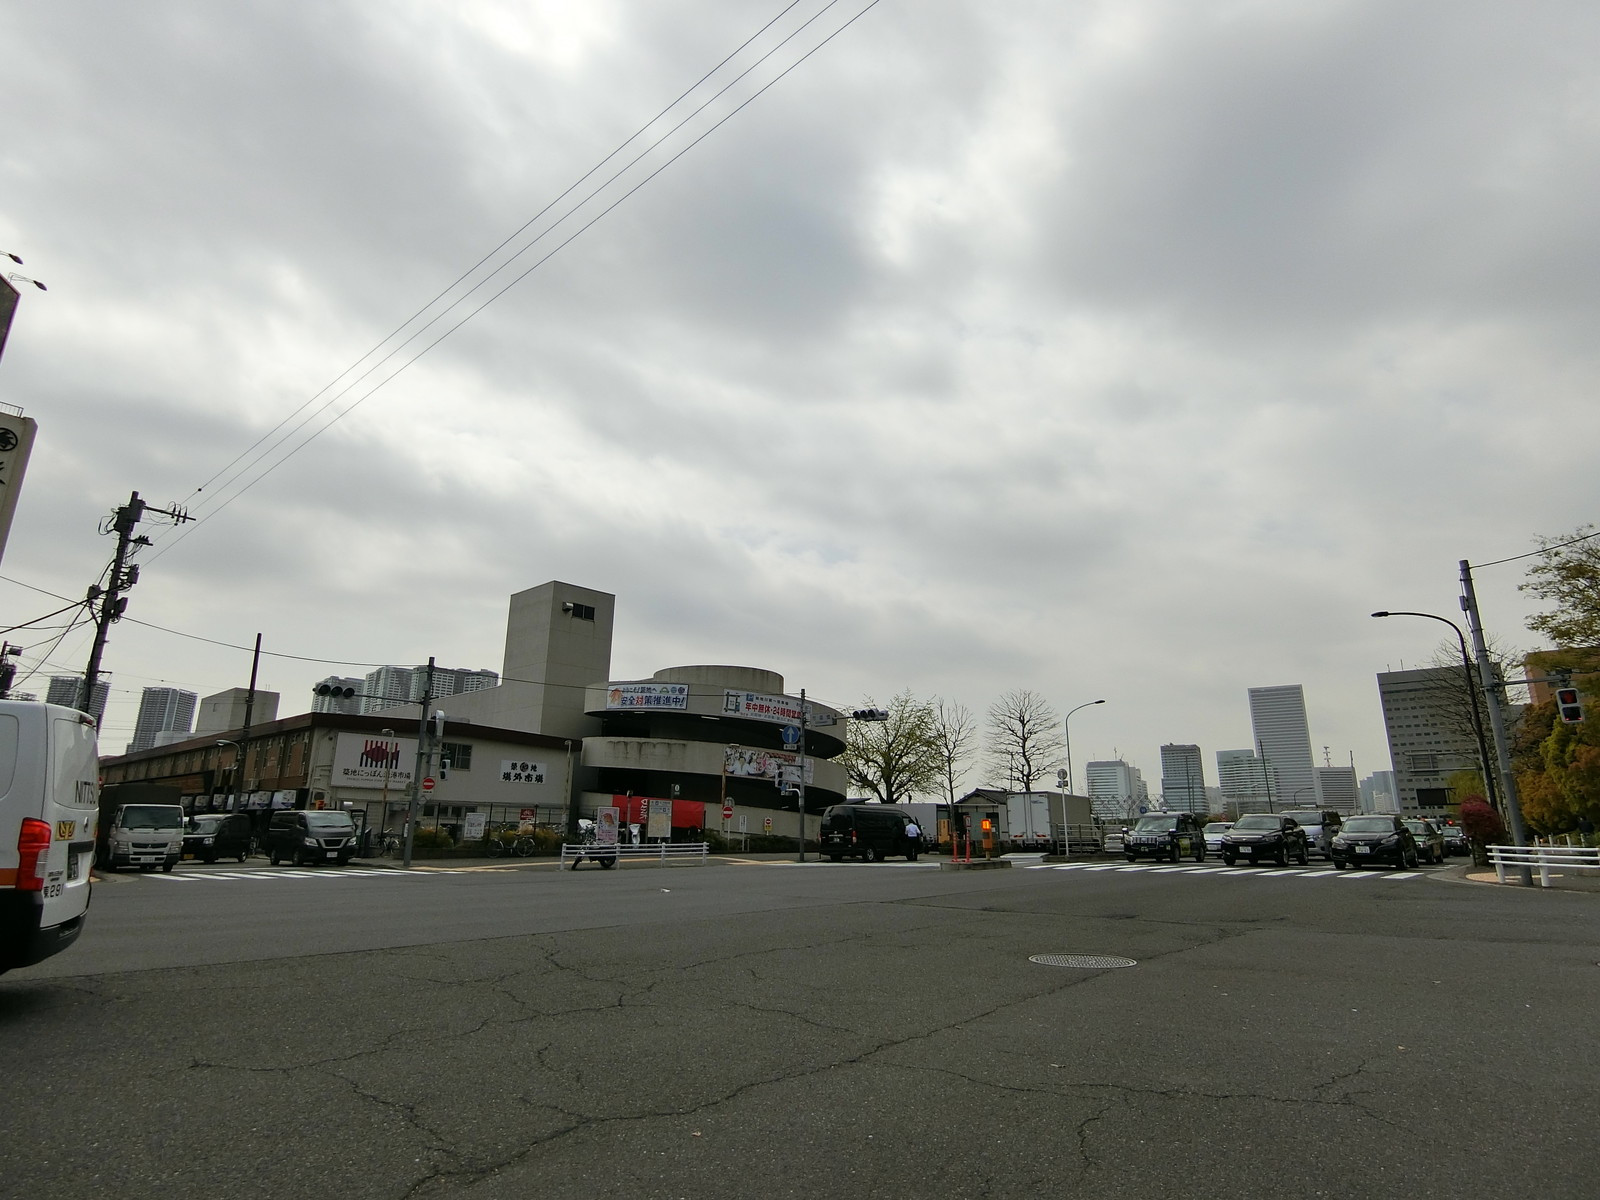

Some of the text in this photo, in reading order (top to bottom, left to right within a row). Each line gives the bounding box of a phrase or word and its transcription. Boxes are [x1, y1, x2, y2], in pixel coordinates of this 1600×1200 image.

[621, 695, 685, 706] 安全対策推進中!
[342, 768, 411, 780] 築地にっぽん港市場
[502, 771, 544, 784] 場外市場
